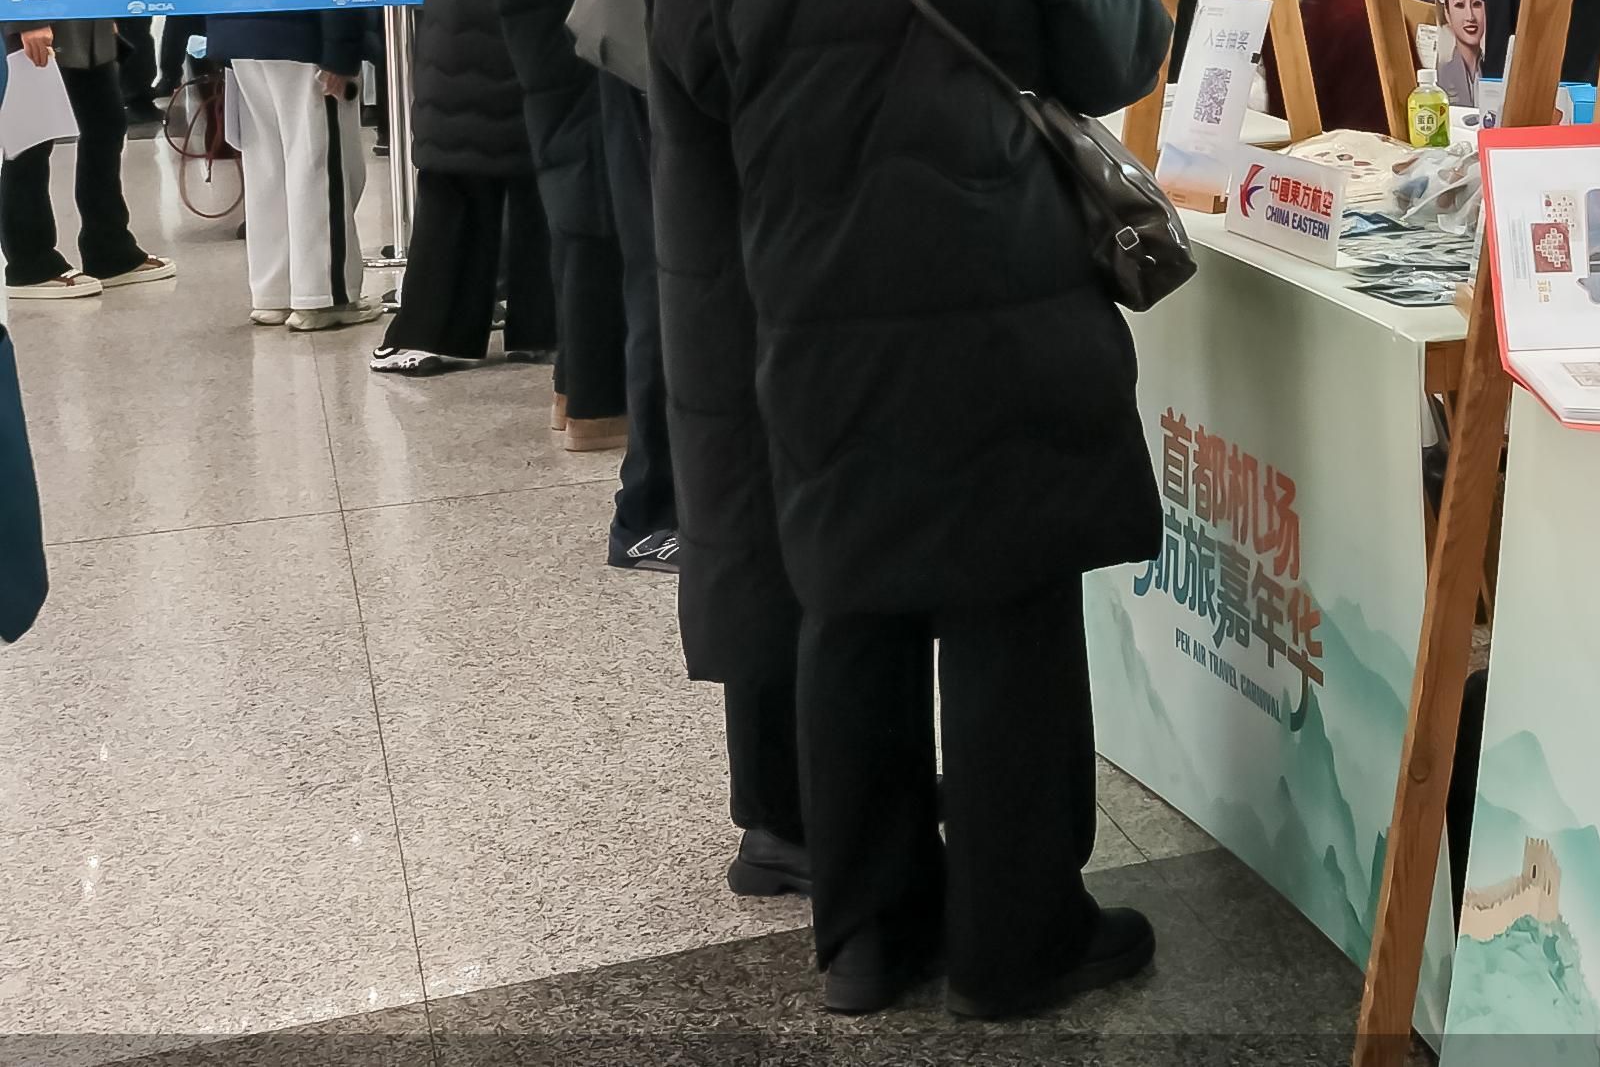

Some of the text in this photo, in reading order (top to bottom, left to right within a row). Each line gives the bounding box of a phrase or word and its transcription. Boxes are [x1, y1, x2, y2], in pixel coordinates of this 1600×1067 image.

[1265, 205, 1330, 241] CHINA EASTERN
[1269, 174, 1334, 218] 中國東方航空
[1160, 406, 1301, 581] 首都机场
[1133, 505, 1325, 734] 航旅嘉年华
[1175, 627, 1191, 656] PEK
[1192, 639, 1207, 668] AIR
[1208, 650, 1239, 691] TRAVEL
